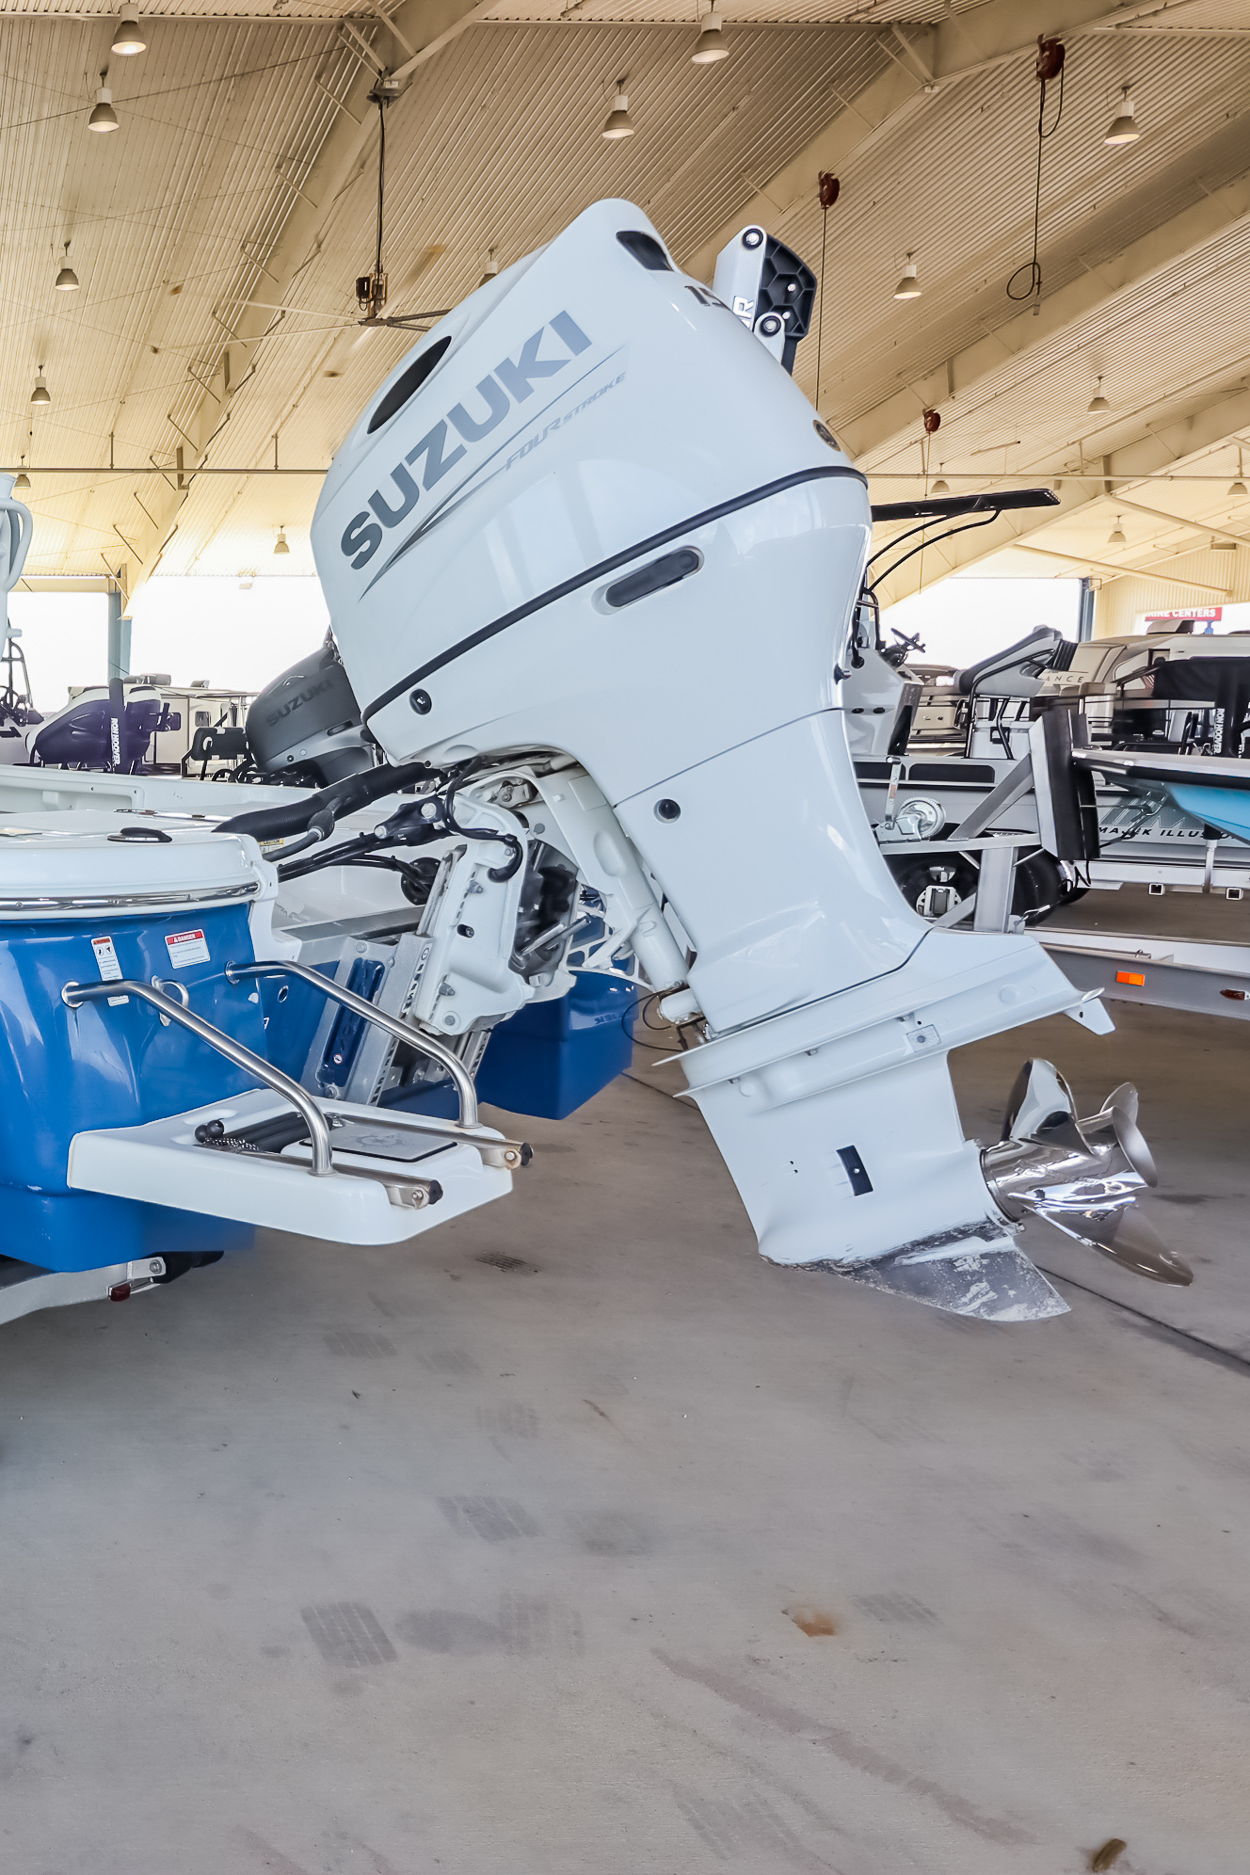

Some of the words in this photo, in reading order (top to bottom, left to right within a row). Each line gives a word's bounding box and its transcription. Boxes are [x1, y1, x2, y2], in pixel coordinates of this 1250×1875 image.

[341, 310, 592, 570] SUZUKI
[505, 417, 563, 471] FOUR
[562, 371, 626, 424] STROKE
[1172, 608, 1216, 618] CENTERS
[266, 680, 334, 727] SUZUKI
[112, 735, 121, 766] HOOVER
